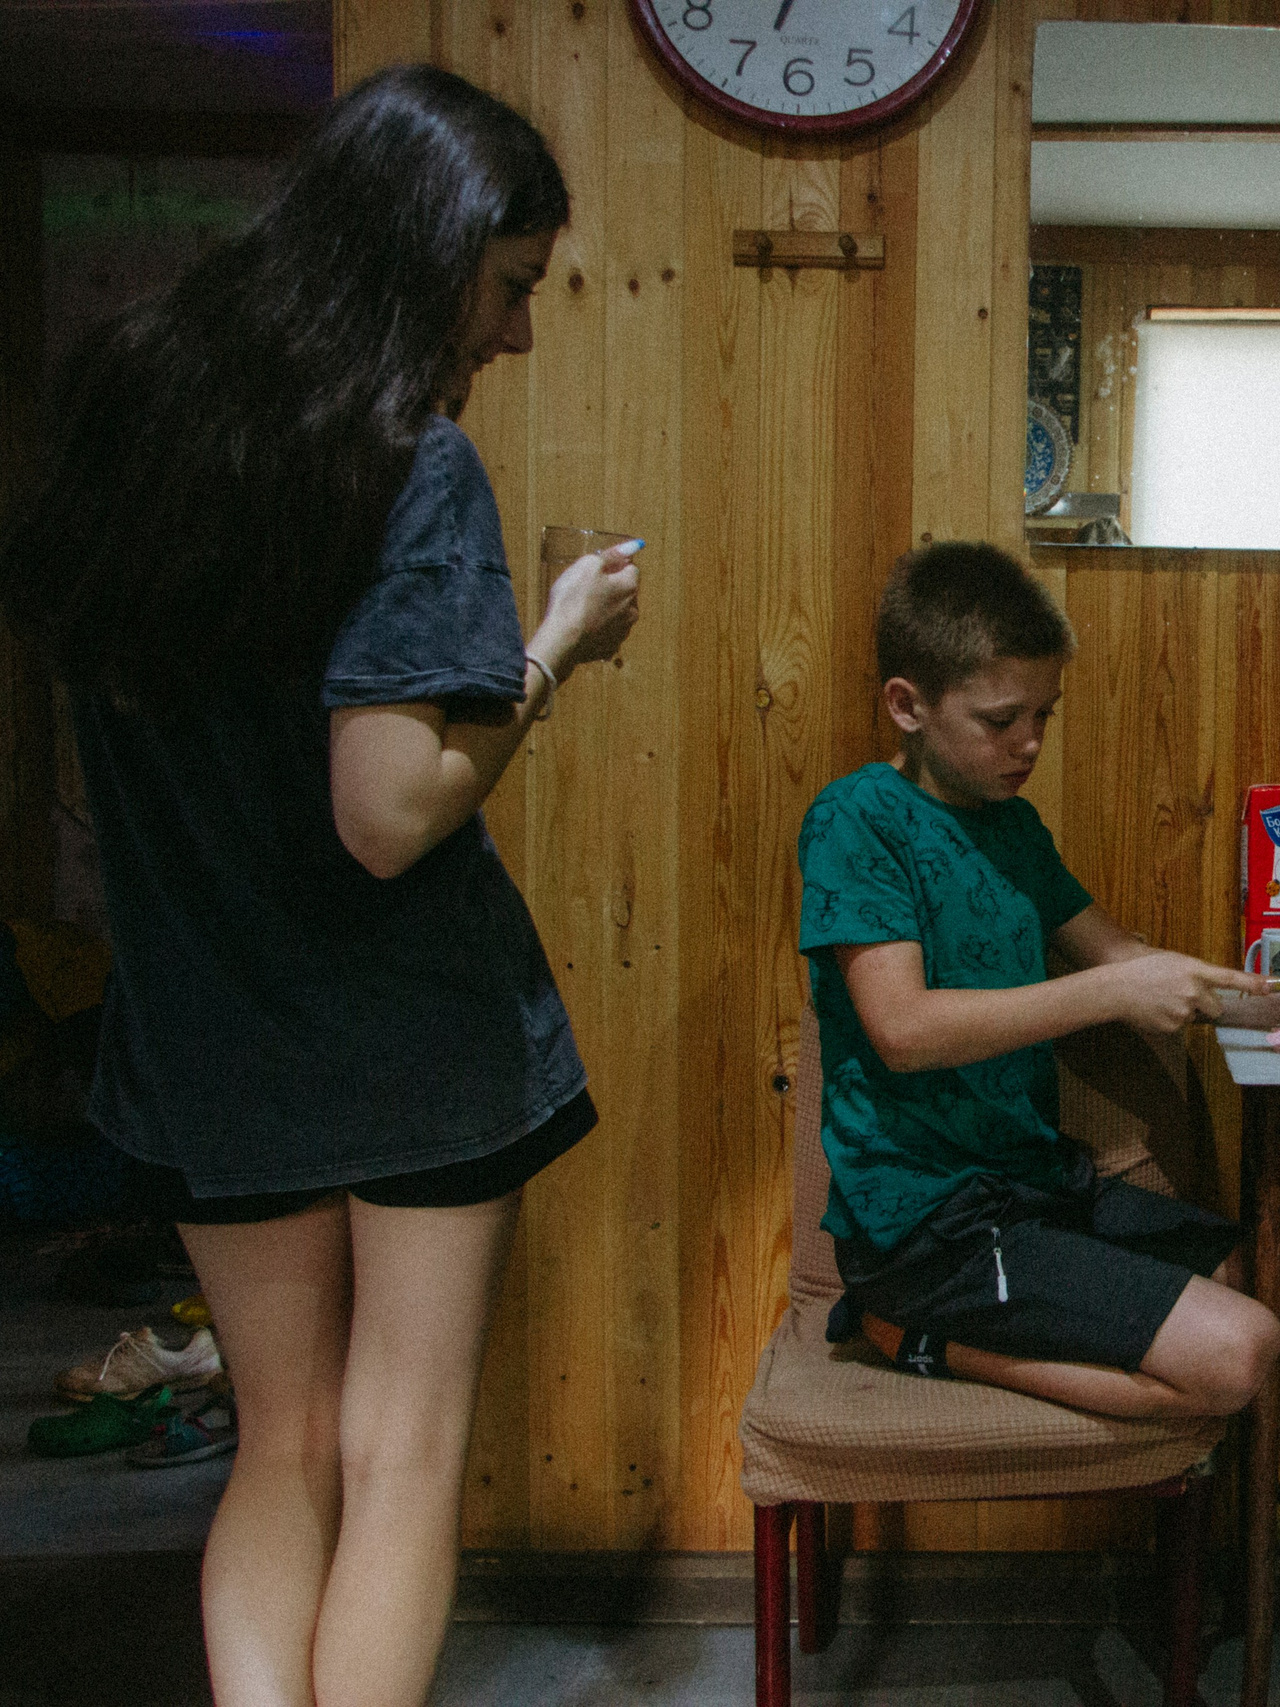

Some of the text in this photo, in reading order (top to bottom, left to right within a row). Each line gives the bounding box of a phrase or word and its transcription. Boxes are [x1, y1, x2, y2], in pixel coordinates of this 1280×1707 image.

[682, 0, 713, 31] 8
[887, 6, 921, 45] 4
[729, 39, 757, 76] 7
[843, 49, 876, 86] 5
[782, 58, 815, 96] 6
